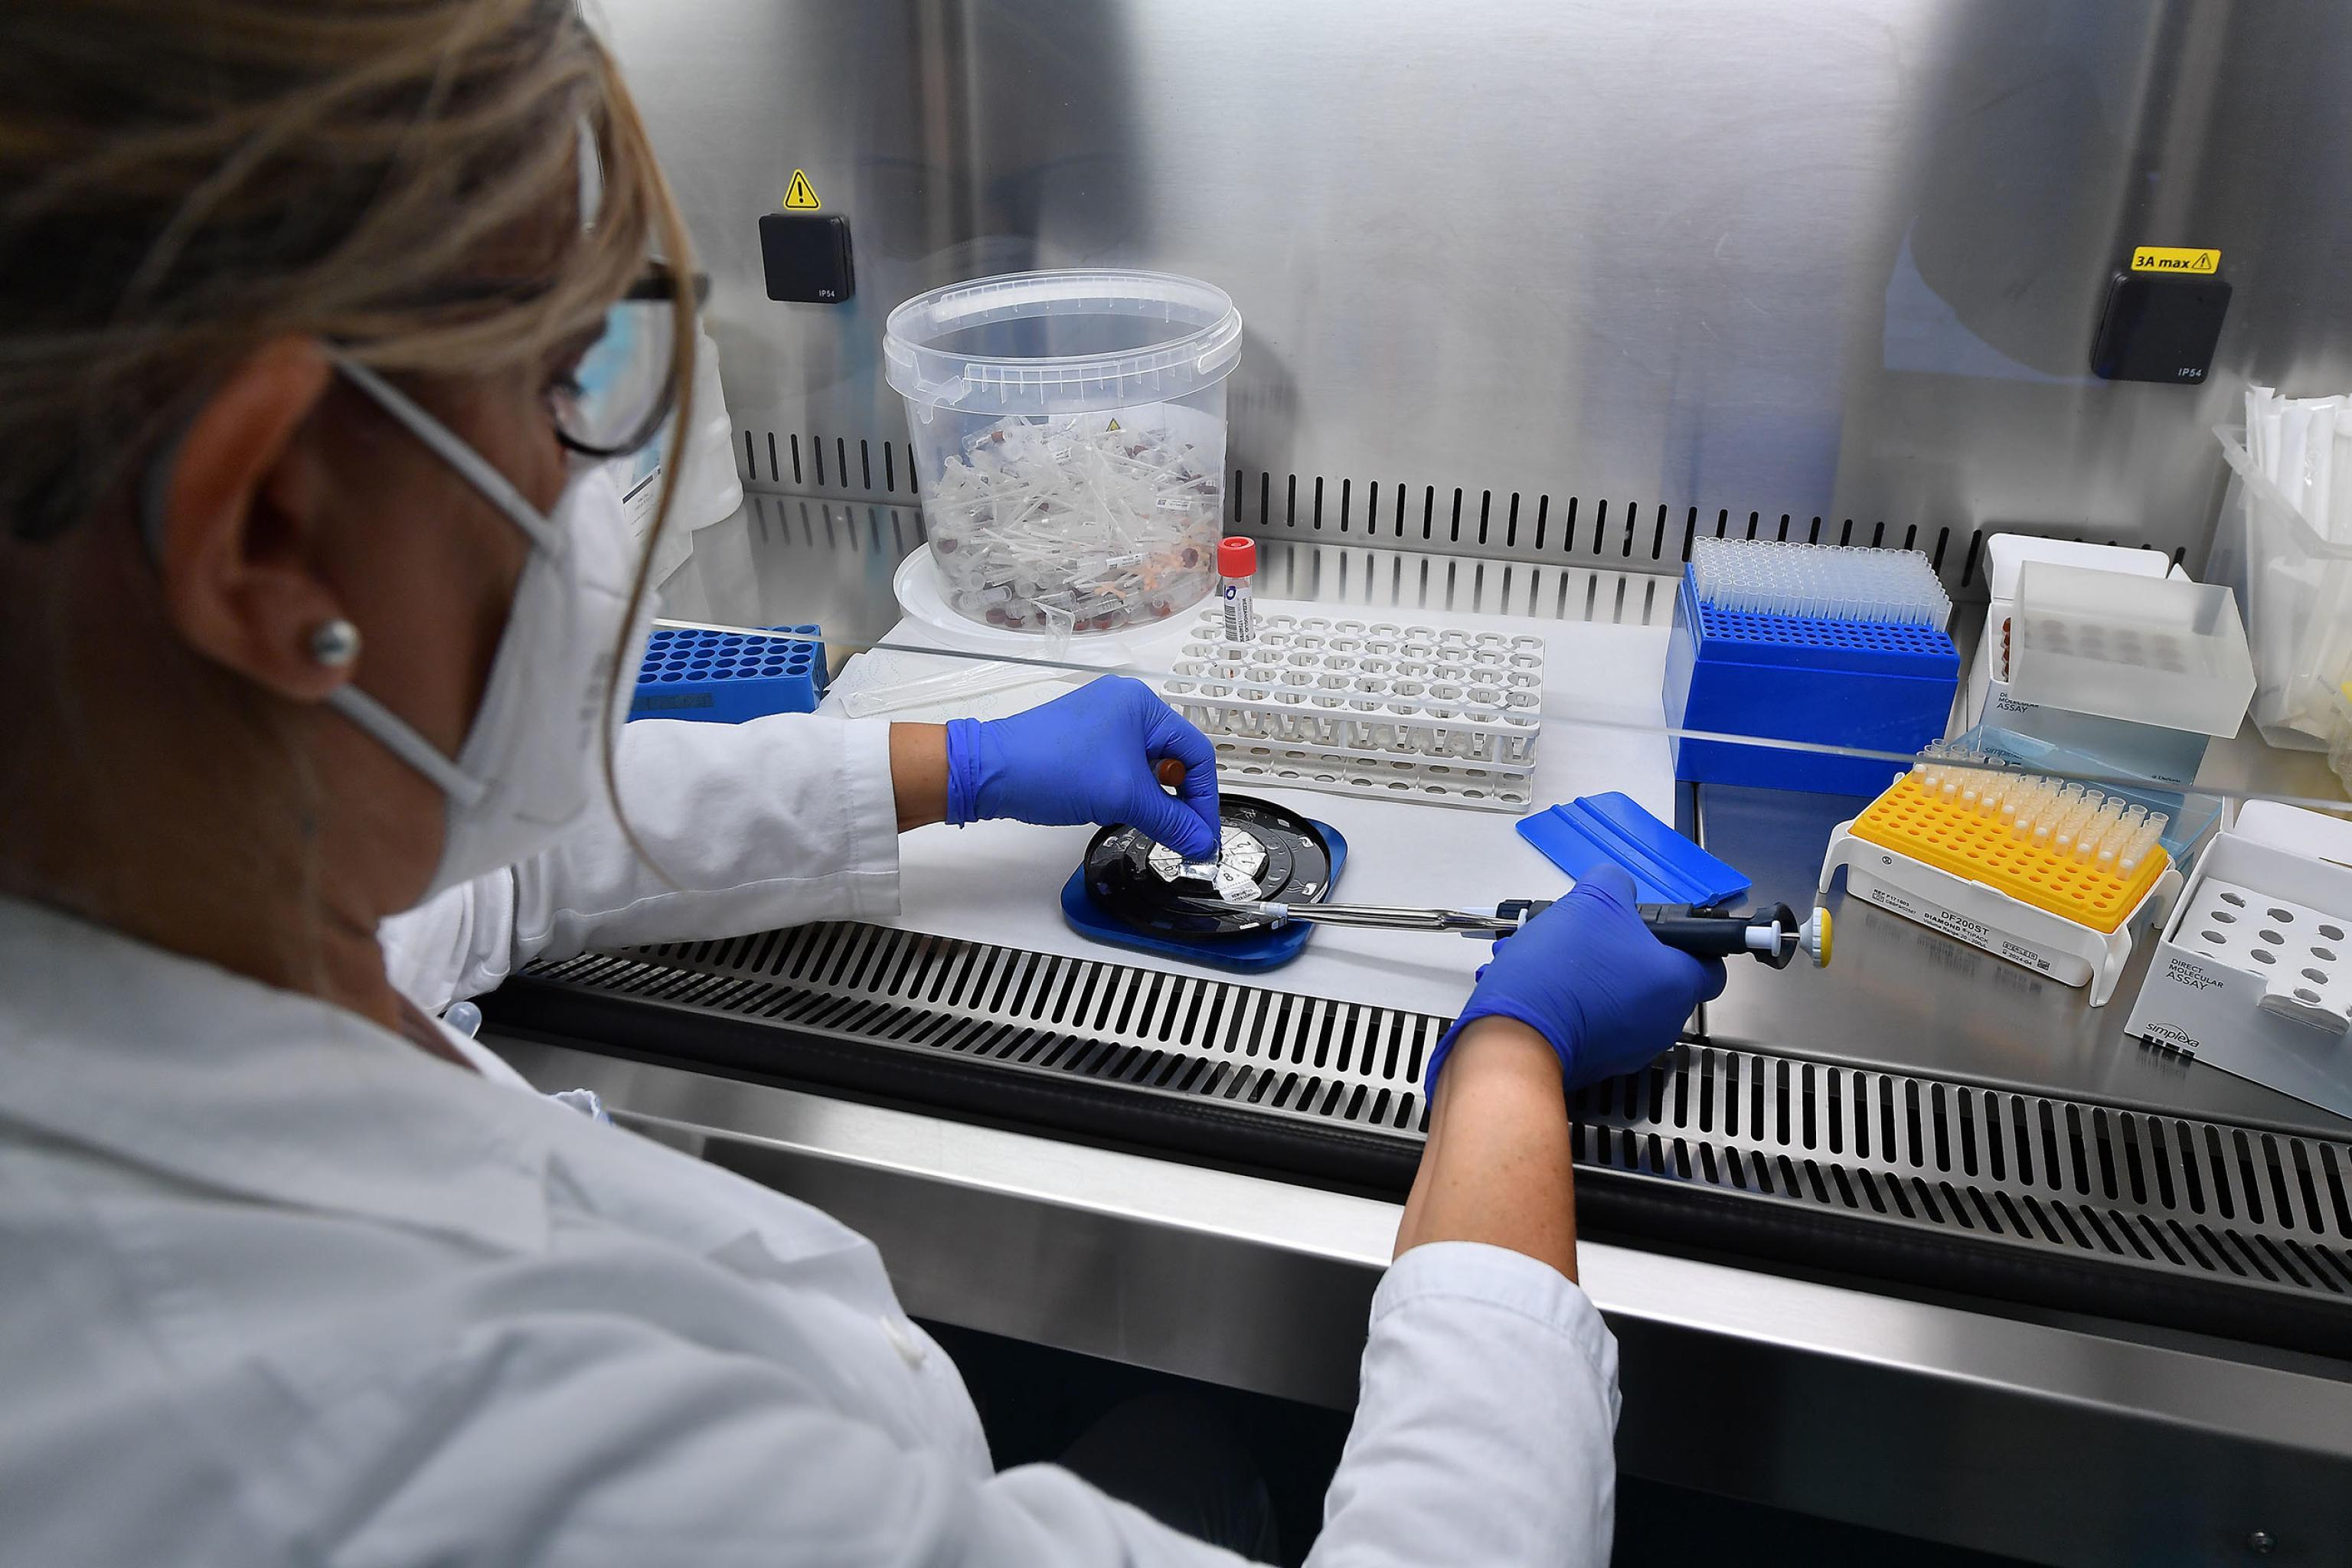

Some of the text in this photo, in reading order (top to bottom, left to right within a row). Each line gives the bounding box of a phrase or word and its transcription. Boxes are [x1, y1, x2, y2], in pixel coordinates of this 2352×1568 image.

[2135, 256, 2190, 269] 3A max
[818, 289, 835, 298] IP54
[2177, 368, 2203, 377] IP54
[1997, 703, 2027, 713] ASSAY
[1223, 872, 1234, 882] 8
[1941, 911, 1990, 936] DF200ST
[2171, 959, 2203, 974] DIRECT
[2166, 972, 2208, 990] ASSAY
[2168, 965, 2224, 988] MOLECULAR
[2146, 1022, 2200, 1048] simplexa
